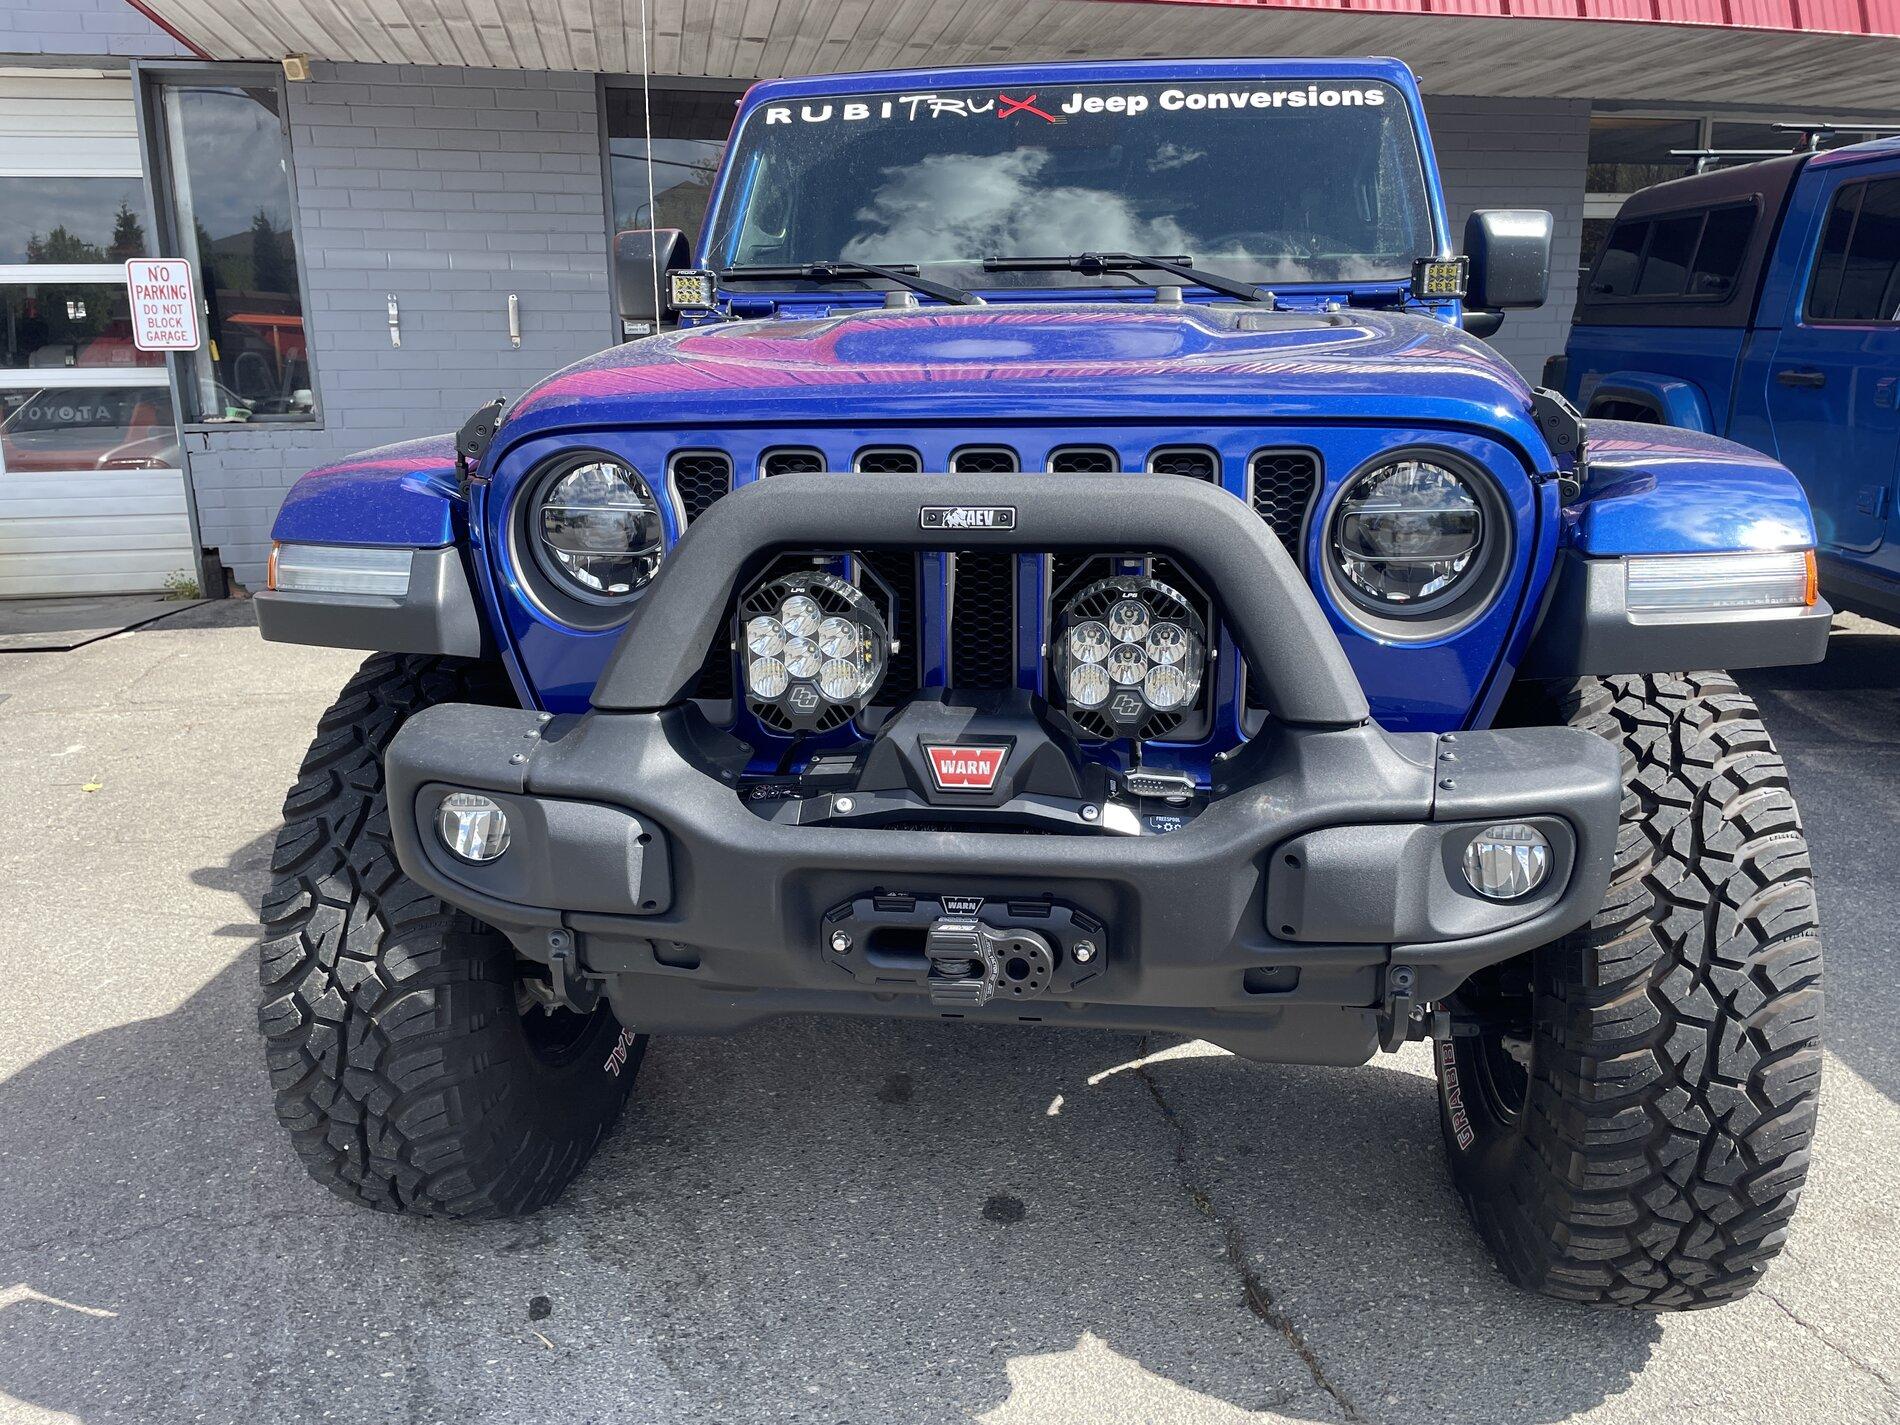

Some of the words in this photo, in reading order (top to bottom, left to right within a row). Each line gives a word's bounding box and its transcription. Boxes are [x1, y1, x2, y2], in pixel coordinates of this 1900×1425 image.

[1061, 92, 1149, 116] Jeep
[1159, 85, 1385, 111] Conversions
[147, 267, 170, 282] NO
[135, 285, 187, 300] PARKING
[143, 304, 158, 315] DO
[162, 304, 183, 315] NOT
[147, 317, 183, 328] BLOCK
[146, 330, 188, 341] GARAGE
[966, 509, 995, 527] AEV
[940, 759, 991, 775] WARN
[947, 901, 976, 910] WARN
[1441, 1036, 1475, 1151] GRABB
